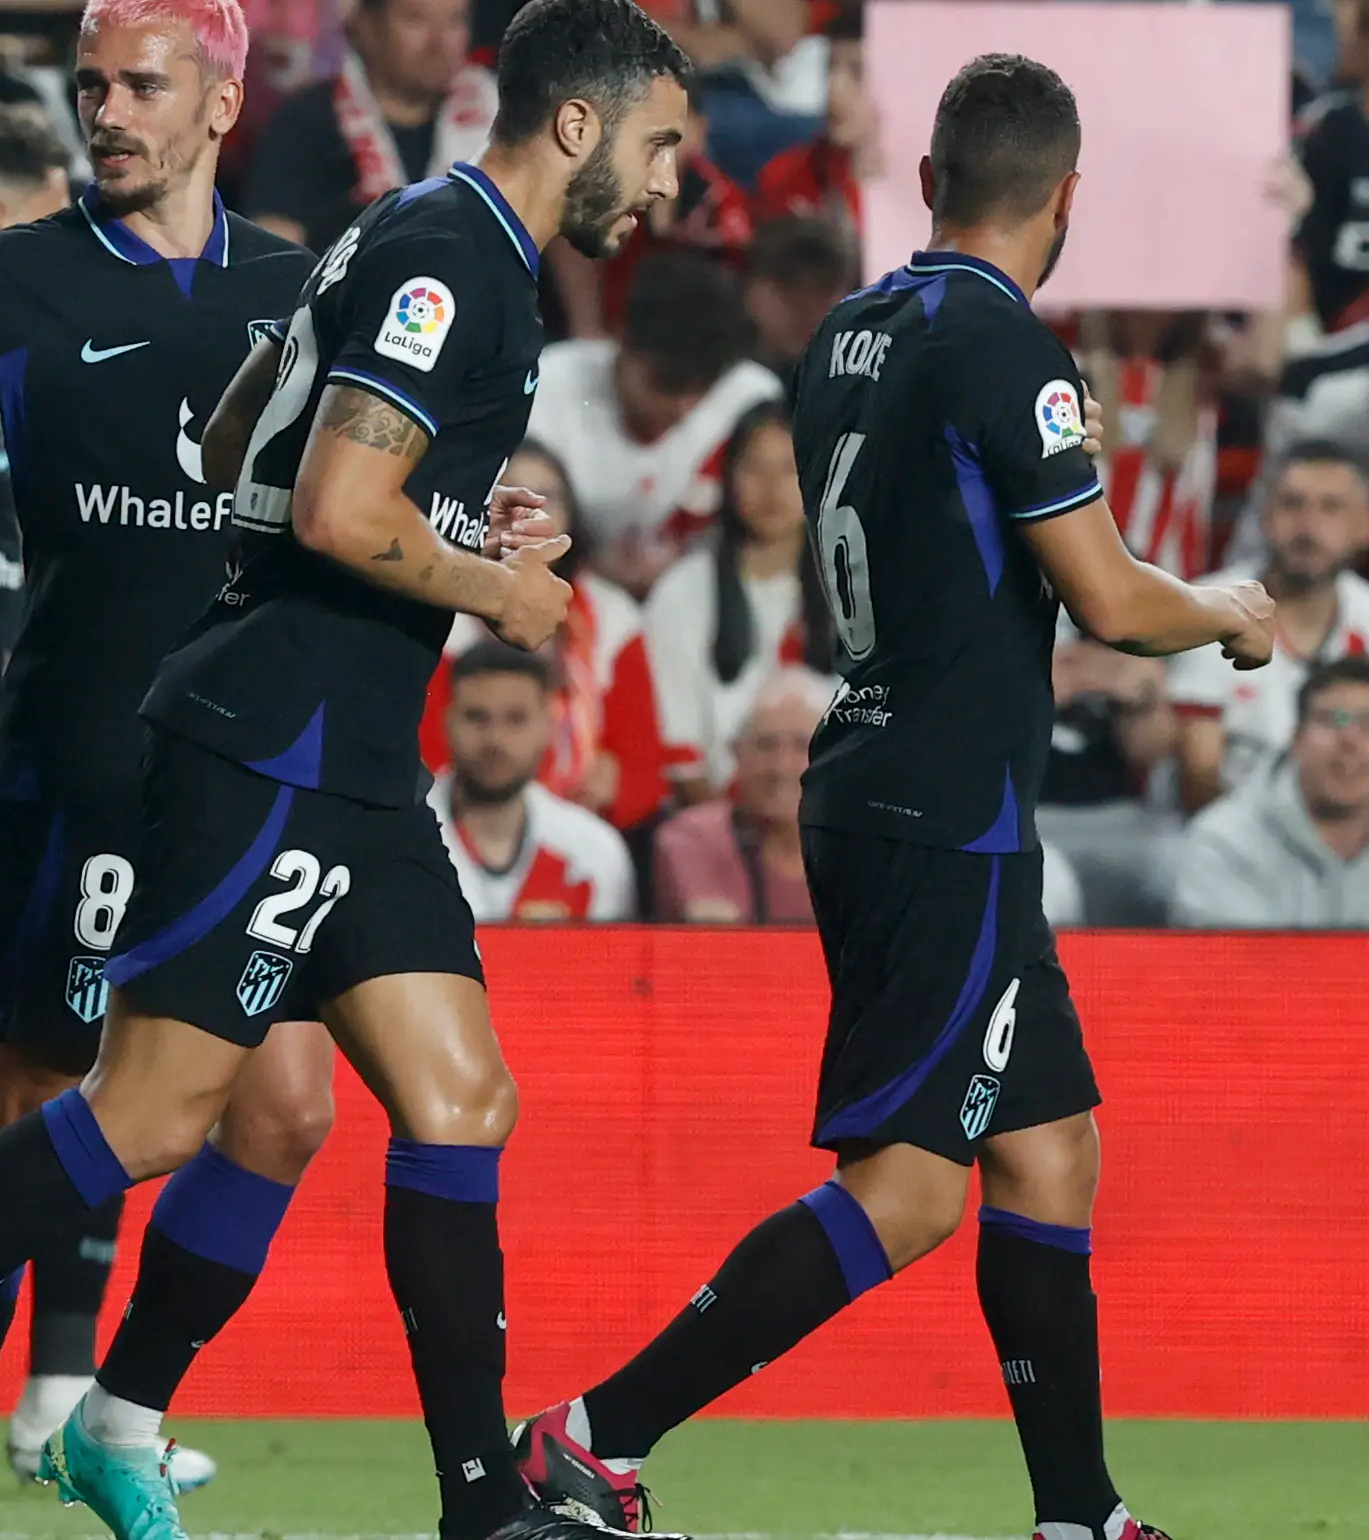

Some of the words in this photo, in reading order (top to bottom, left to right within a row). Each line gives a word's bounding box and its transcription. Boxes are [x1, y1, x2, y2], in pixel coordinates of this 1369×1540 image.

[384, 331, 432, 357] LaLiga
[817, 432, 876, 661] 6
[832, 705, 892, 727] Transfer
[843, 684, 891, 706] oney
[74, 853, 135, 951] 8
[982, 977, 1021, 1073] 6
